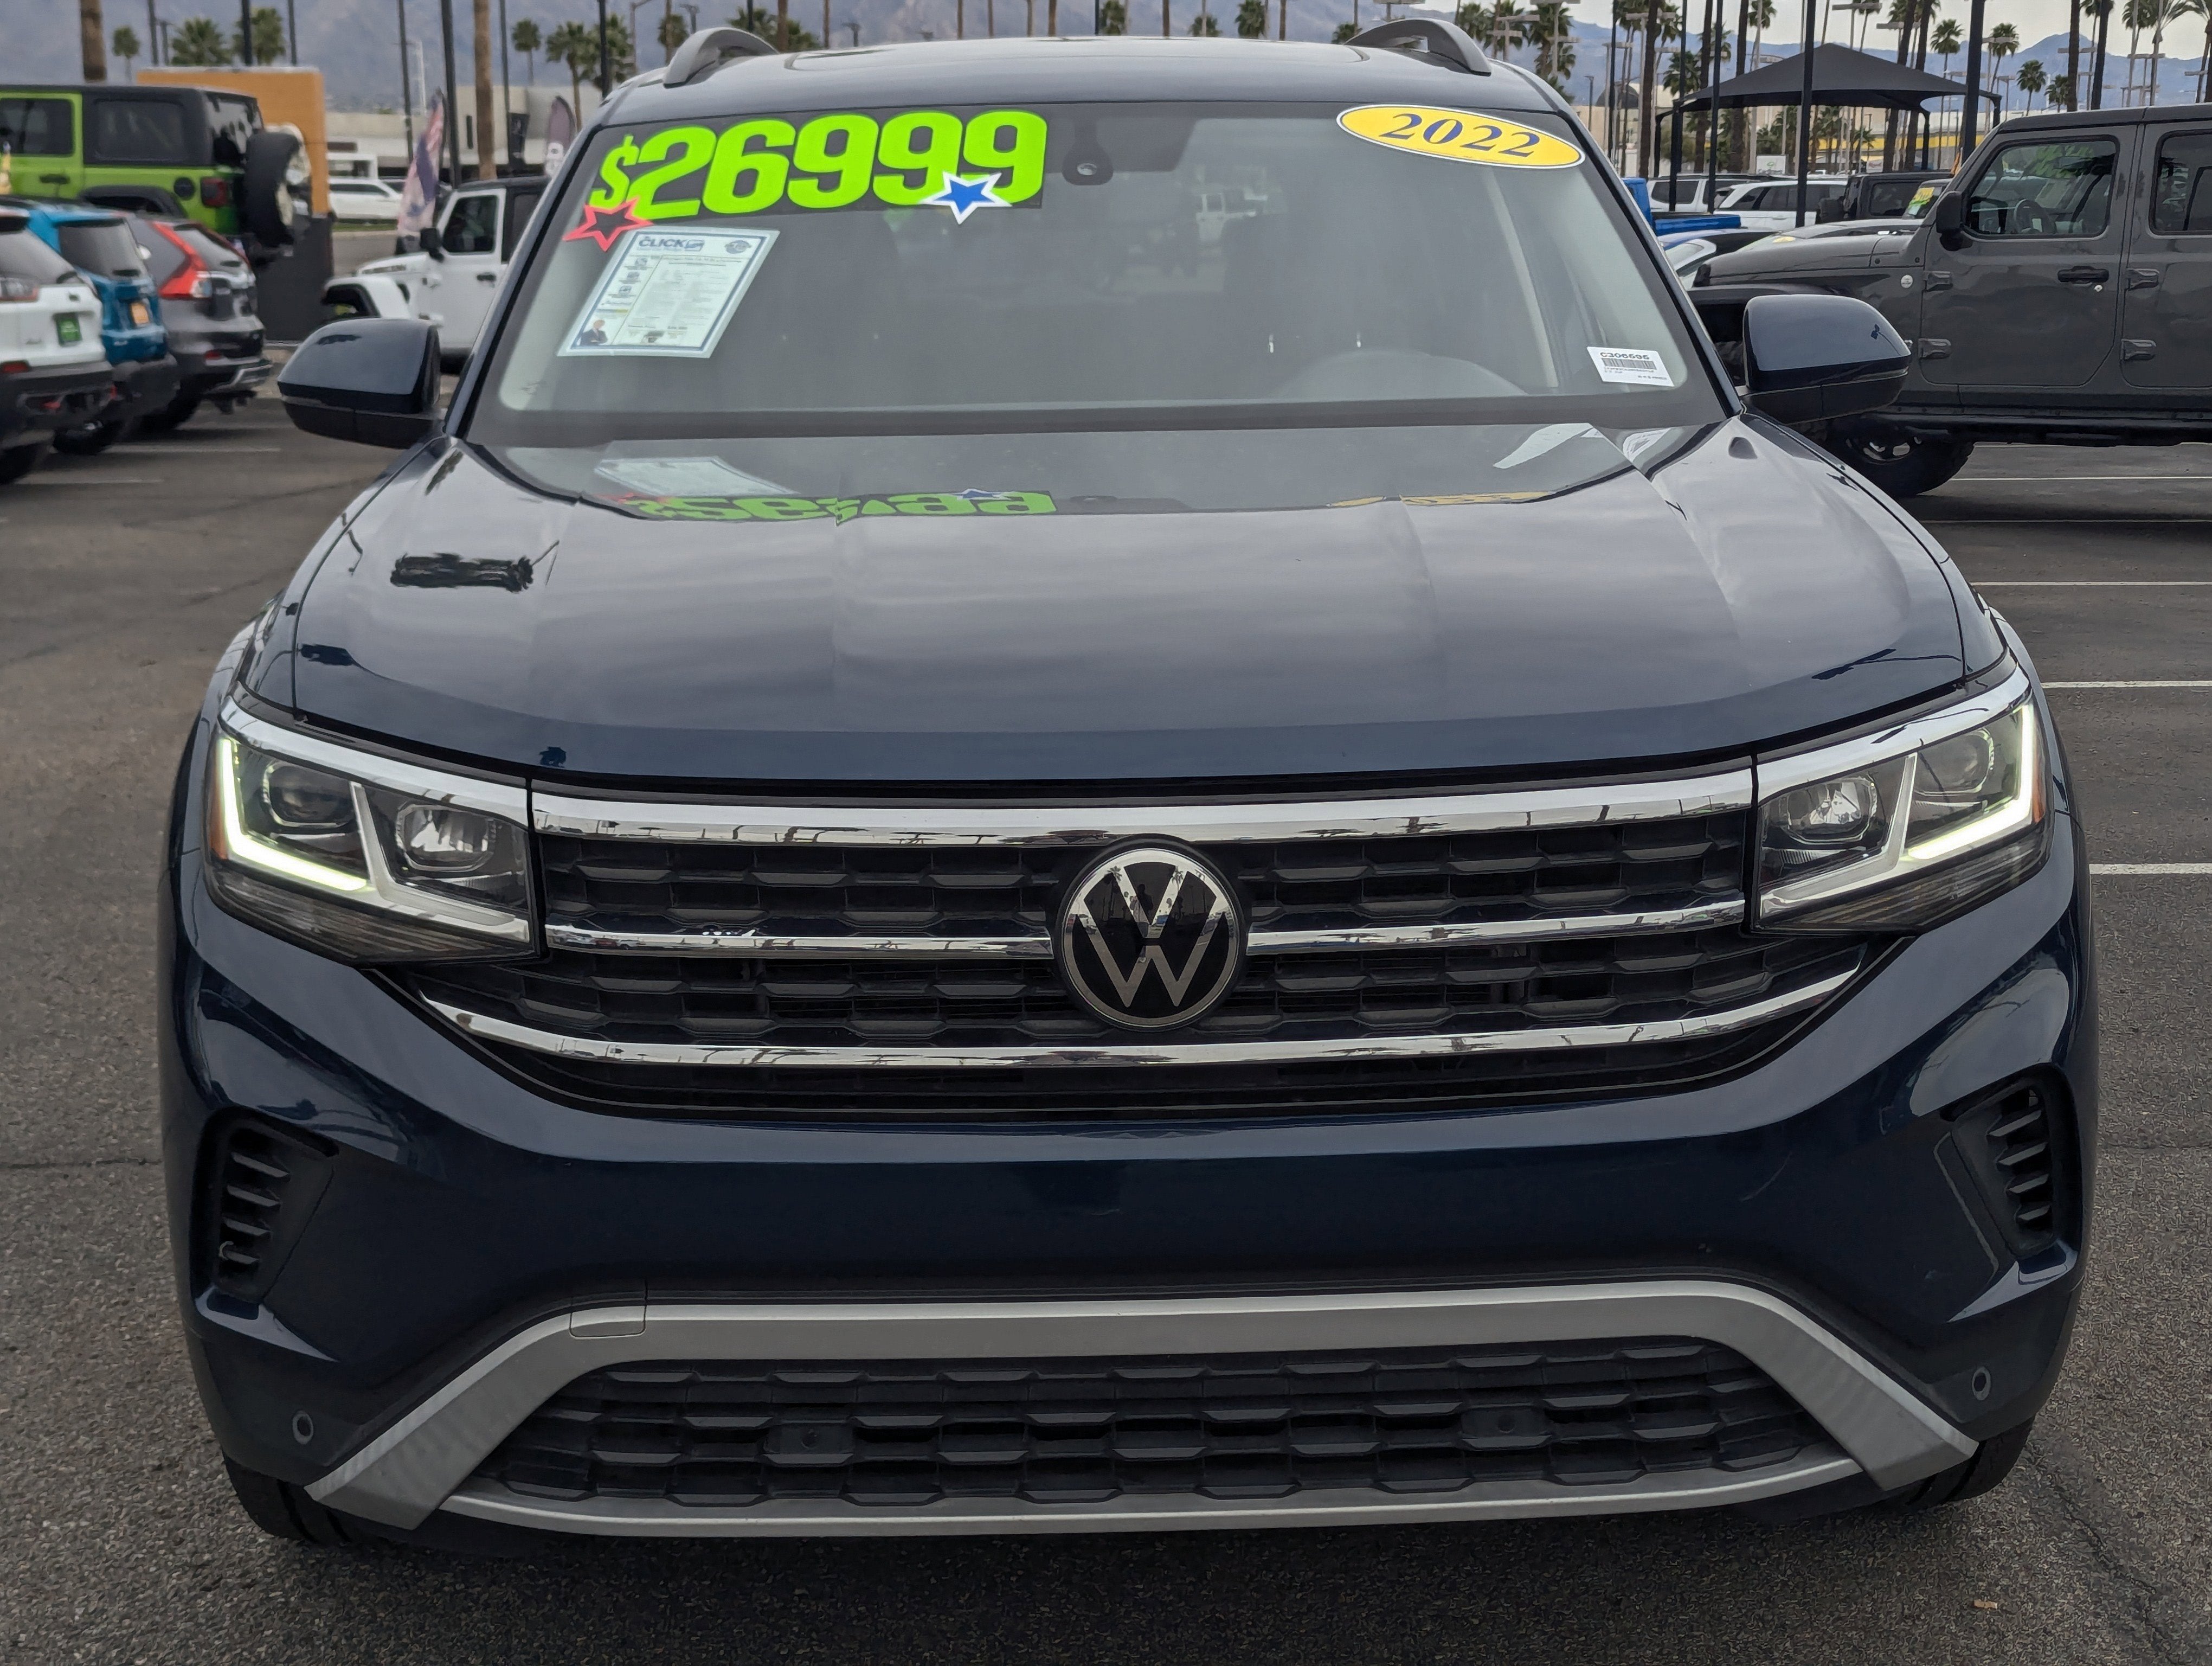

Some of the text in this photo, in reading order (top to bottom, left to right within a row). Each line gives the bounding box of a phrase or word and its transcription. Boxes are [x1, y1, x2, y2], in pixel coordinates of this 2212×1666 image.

[591, 111, 1047, 220] $26999
[1379, 113, 1540, 157] 2022
[639, 238, 687, 247] CLICK
[1071, 860, 1230, 1011] VW
